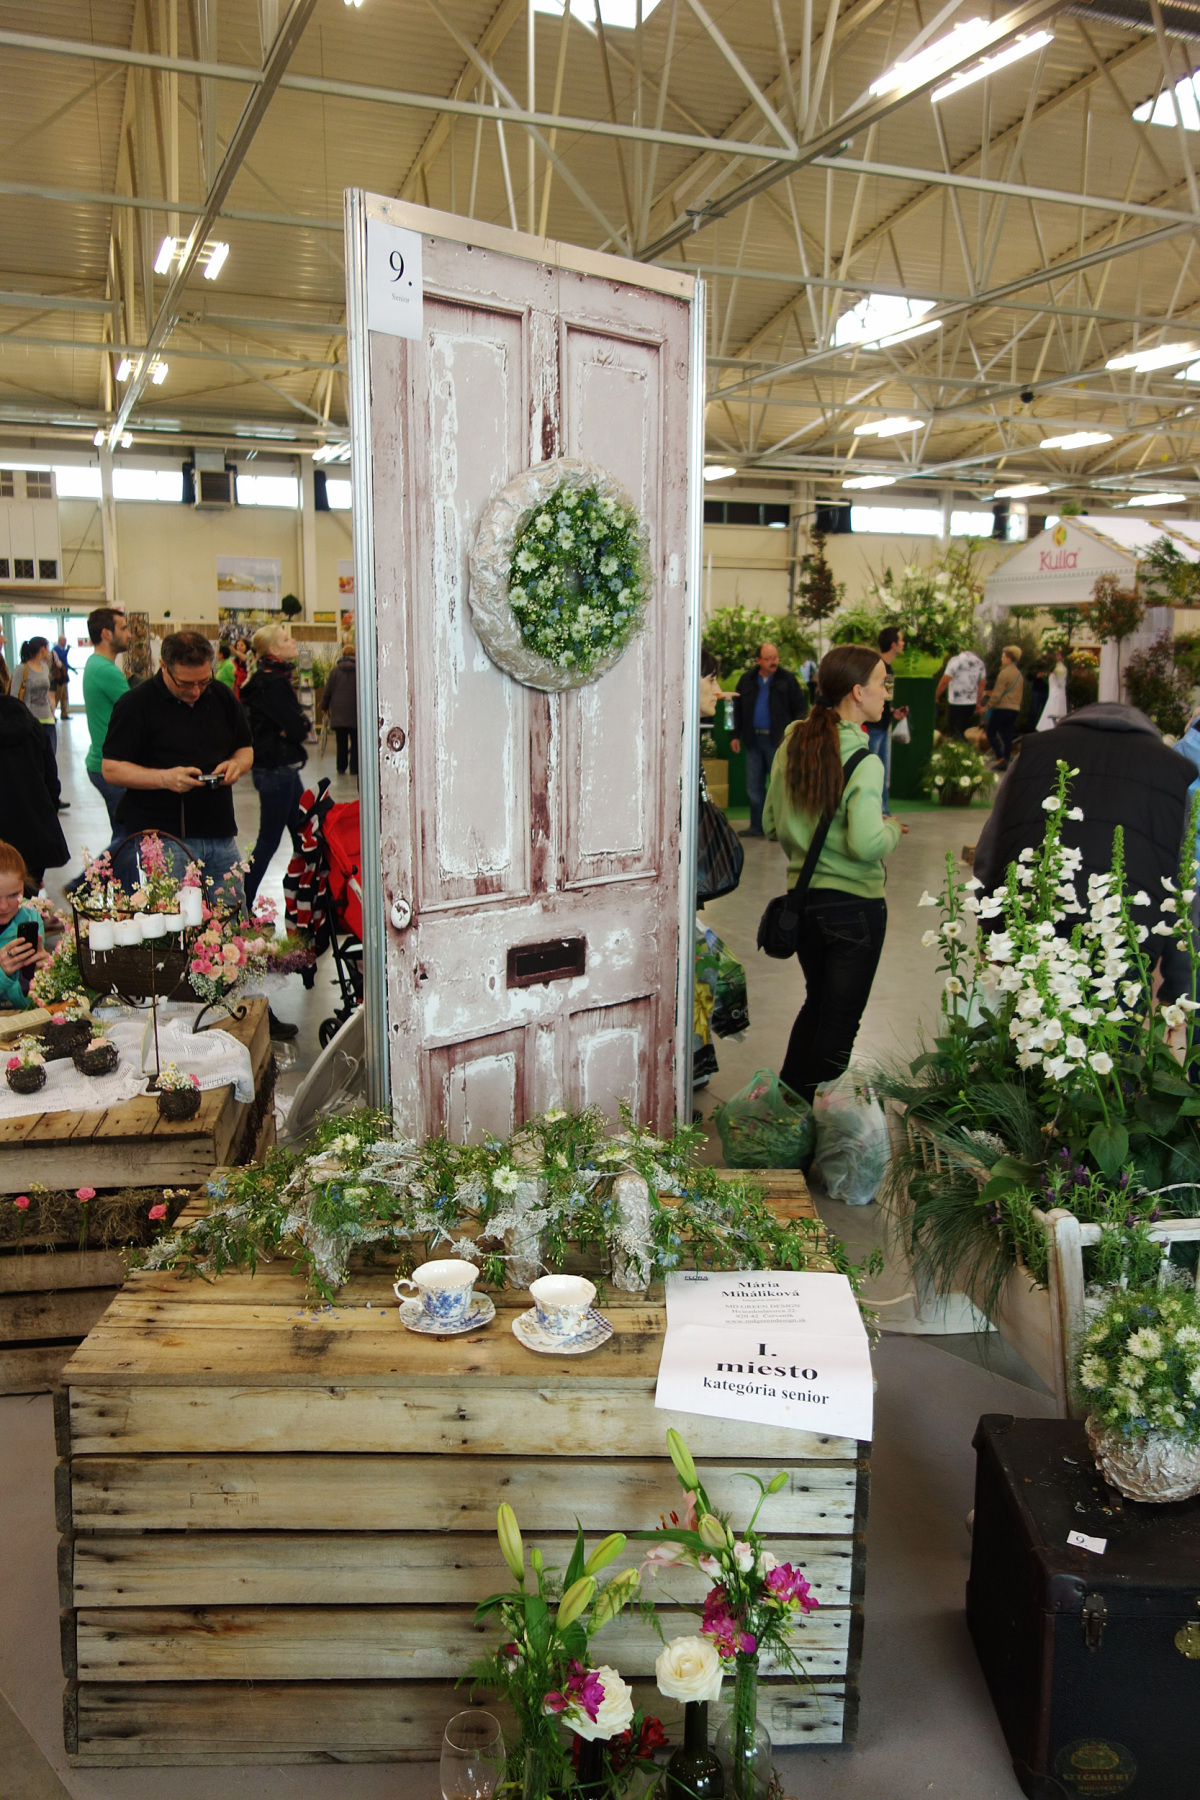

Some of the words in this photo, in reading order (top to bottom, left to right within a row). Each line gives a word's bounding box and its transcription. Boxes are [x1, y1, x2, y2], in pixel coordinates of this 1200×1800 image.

[389, 250, 413, 287] 9.
[391, 292, 411, 304] Senior
[1038, 549, 1078, 571] Kulla
[721, 1289, 800, 1298] Miháliková
[757, 1343, 778, 1357] I.
[716, 1361, 818, 1381] miesto
[703, 1376, 776, 1398] kategória
[781, 1387, 830, 1405] senior
